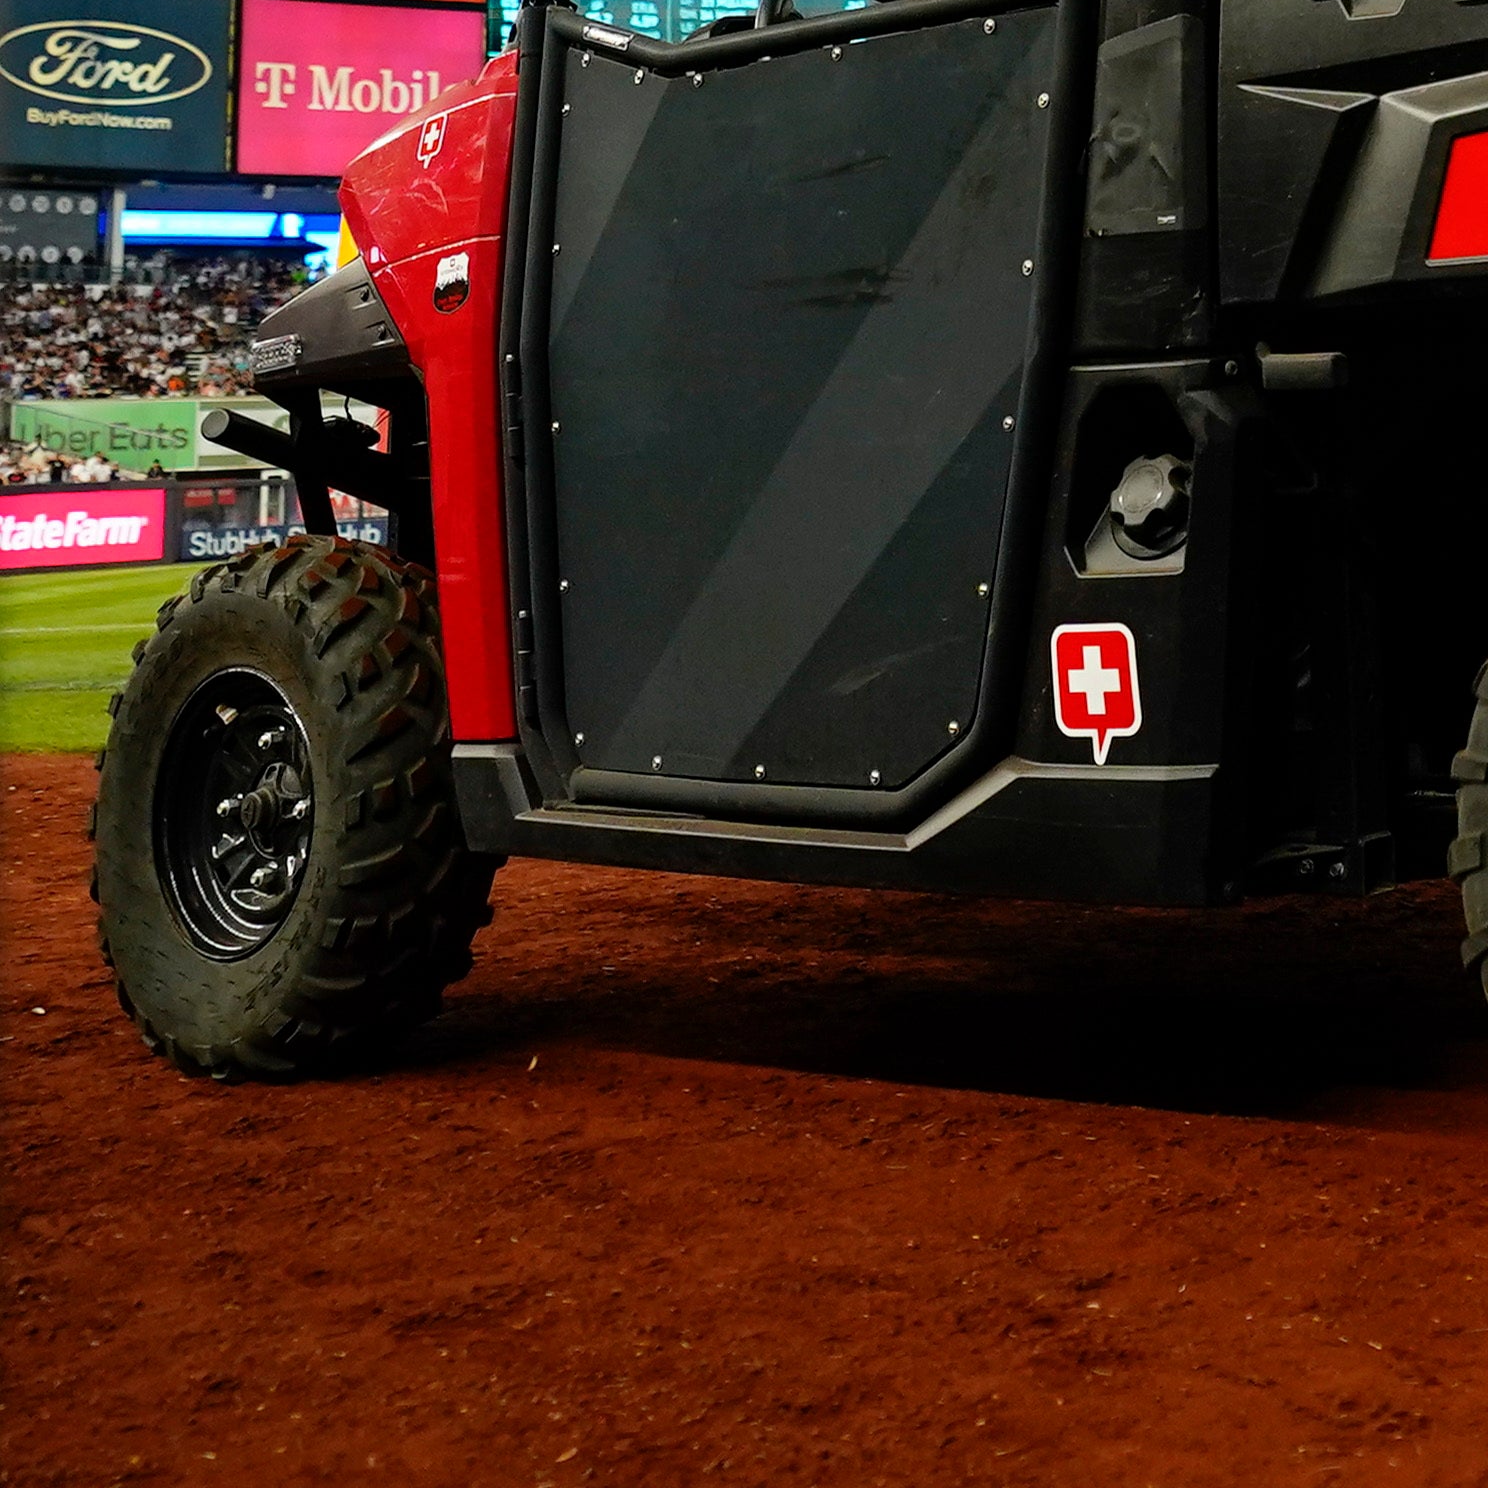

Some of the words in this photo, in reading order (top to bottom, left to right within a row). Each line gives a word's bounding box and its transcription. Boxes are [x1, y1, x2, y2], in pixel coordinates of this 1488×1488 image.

[29, 28, 176, 95] Ford
[254, 61, 296, 110] T
[307, 64, 457, 114] Mobil
[26, 107, 172, 131] BuyFordNow.com
[16, 415, 99, 455] Uber
[108, 420, 189, 453] Eats
